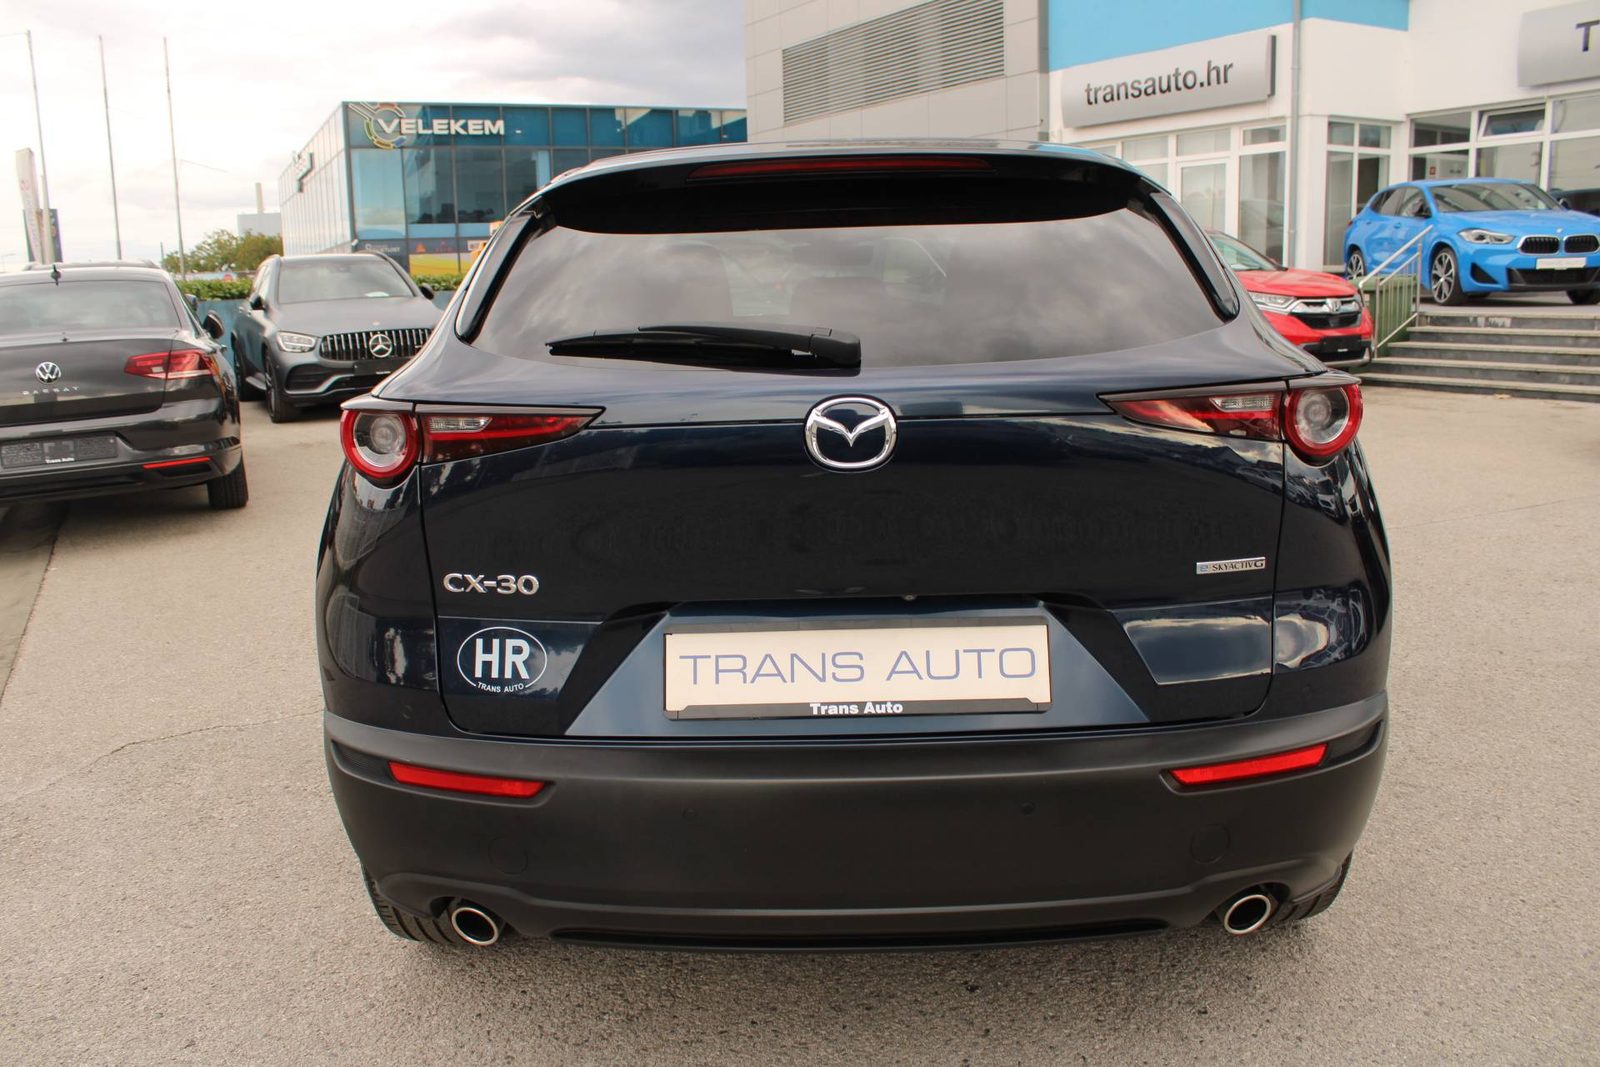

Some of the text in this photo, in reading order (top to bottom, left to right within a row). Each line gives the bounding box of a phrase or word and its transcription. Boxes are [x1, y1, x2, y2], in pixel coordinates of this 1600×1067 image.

[1085, 60, 1233, 105] transauto.hr
[377, 118, 505, 135] VELEKEM
[443, 573, 540, 595] CX-30
[474, 638, 530, 679] HR
[679, 647, 1036, 685] TRANS AUTO
[477, 682, 524, 693] TRANS AUTO
[809, 701, 904, 715] Trans Auto
